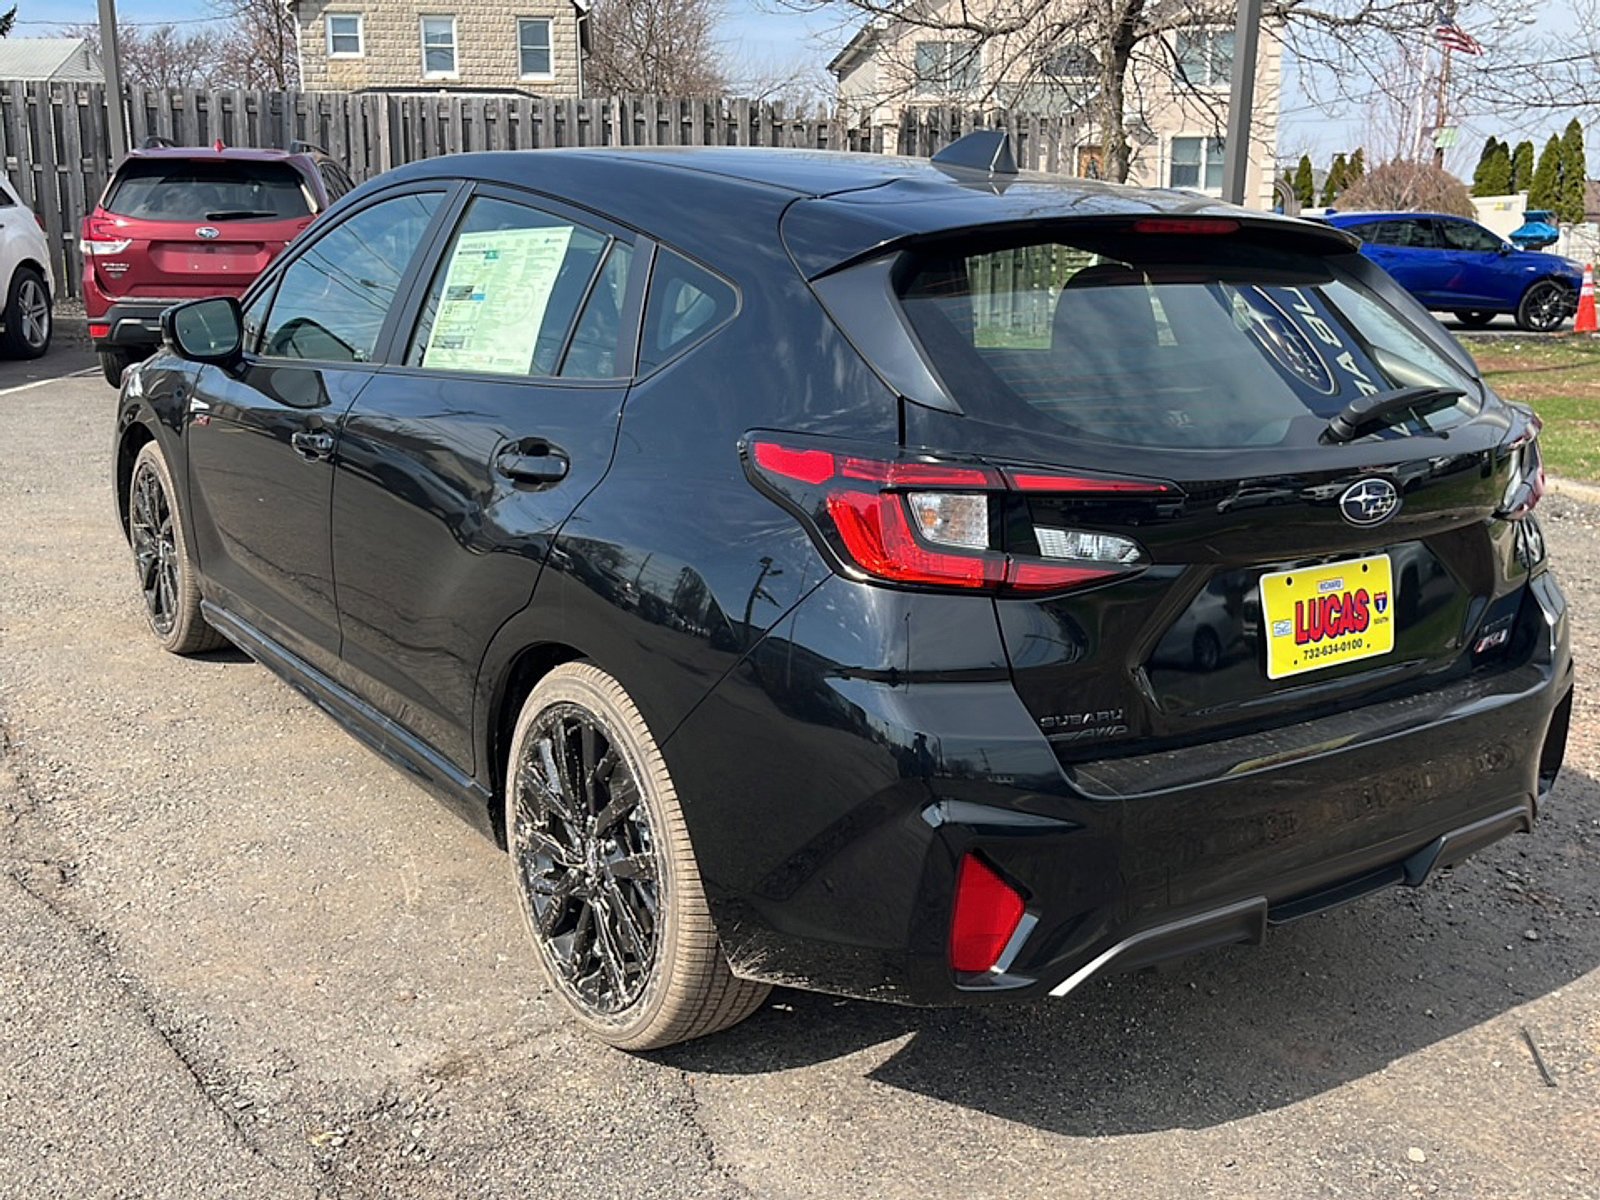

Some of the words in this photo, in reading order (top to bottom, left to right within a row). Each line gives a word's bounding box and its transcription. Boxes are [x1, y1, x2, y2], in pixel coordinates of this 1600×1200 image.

[1295, 588, 1370, 645] LUCAS
[1303, 638, 1362, 659] 732-634-0100
[1040, 709, 1123, 727] SUBARU
